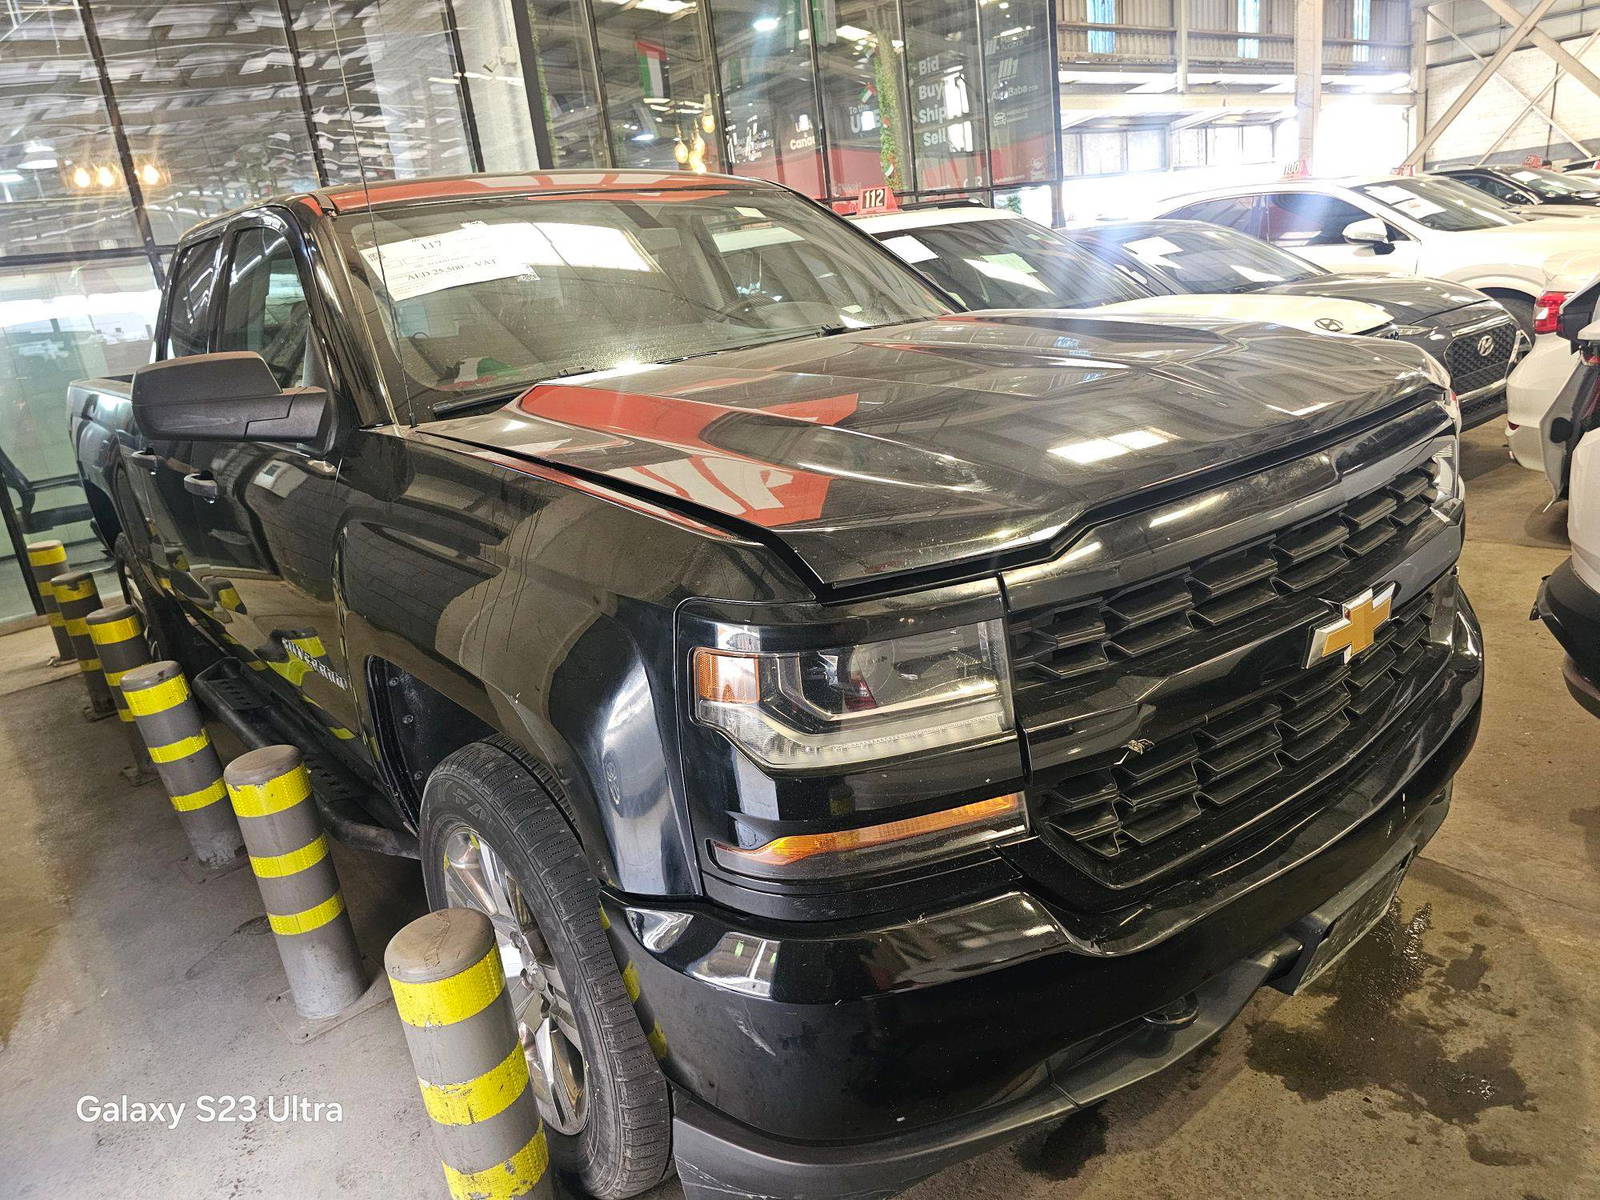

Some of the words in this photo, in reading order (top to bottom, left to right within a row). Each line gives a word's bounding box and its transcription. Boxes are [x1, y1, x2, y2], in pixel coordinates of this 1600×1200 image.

[919, 56, 939, 75] Bid
[919, 81, 945, 100] Buy
[848, 106, 857, 115] To
[919, 104, 947, 124] Ship
[850, 109, 881, 133] UE
[923, 127, 947, 146] Sell
[864, 189, 884, 208] 112
